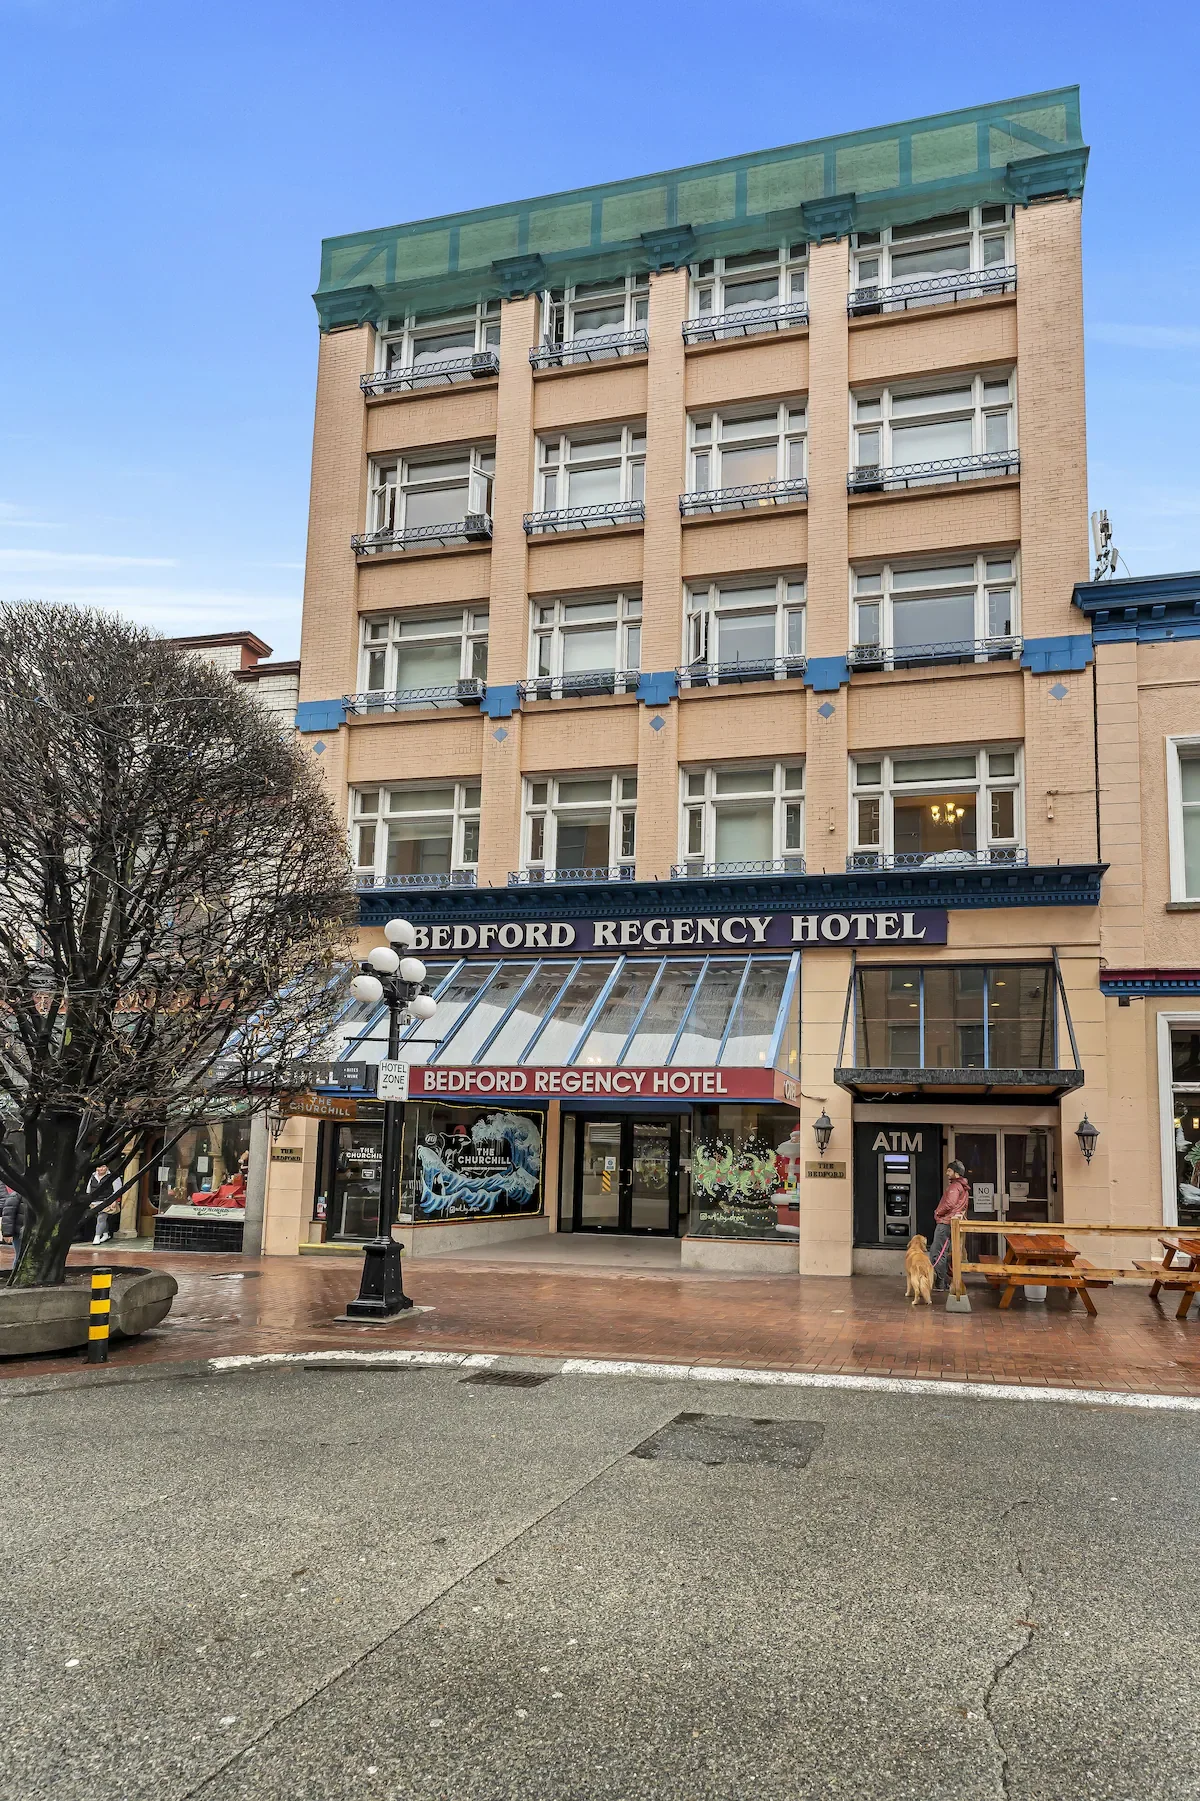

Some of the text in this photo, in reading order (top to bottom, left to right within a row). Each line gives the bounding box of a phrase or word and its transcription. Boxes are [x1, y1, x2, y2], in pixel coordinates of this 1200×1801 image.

[407, 911, 927, 950] BEDFORD REGENCY HOTEL
[381, 1062, 407, 1073] HOTEL
[382, 1074, 405, 1084] ZONE
[423, 1071, 728, 1094] BEDFORD REGENCY HOTEL
[311, 1096, 332, 1106] THE
[289, 1102, 351, 1116] CHURCHILL
[872, 1131, 923, 1152] ATM
[476, 1147, 495, 1156] THE
[457, 1155, 511, 1165] CHURCHILL
[807, 1170, 844, 1178] BEDFORD
